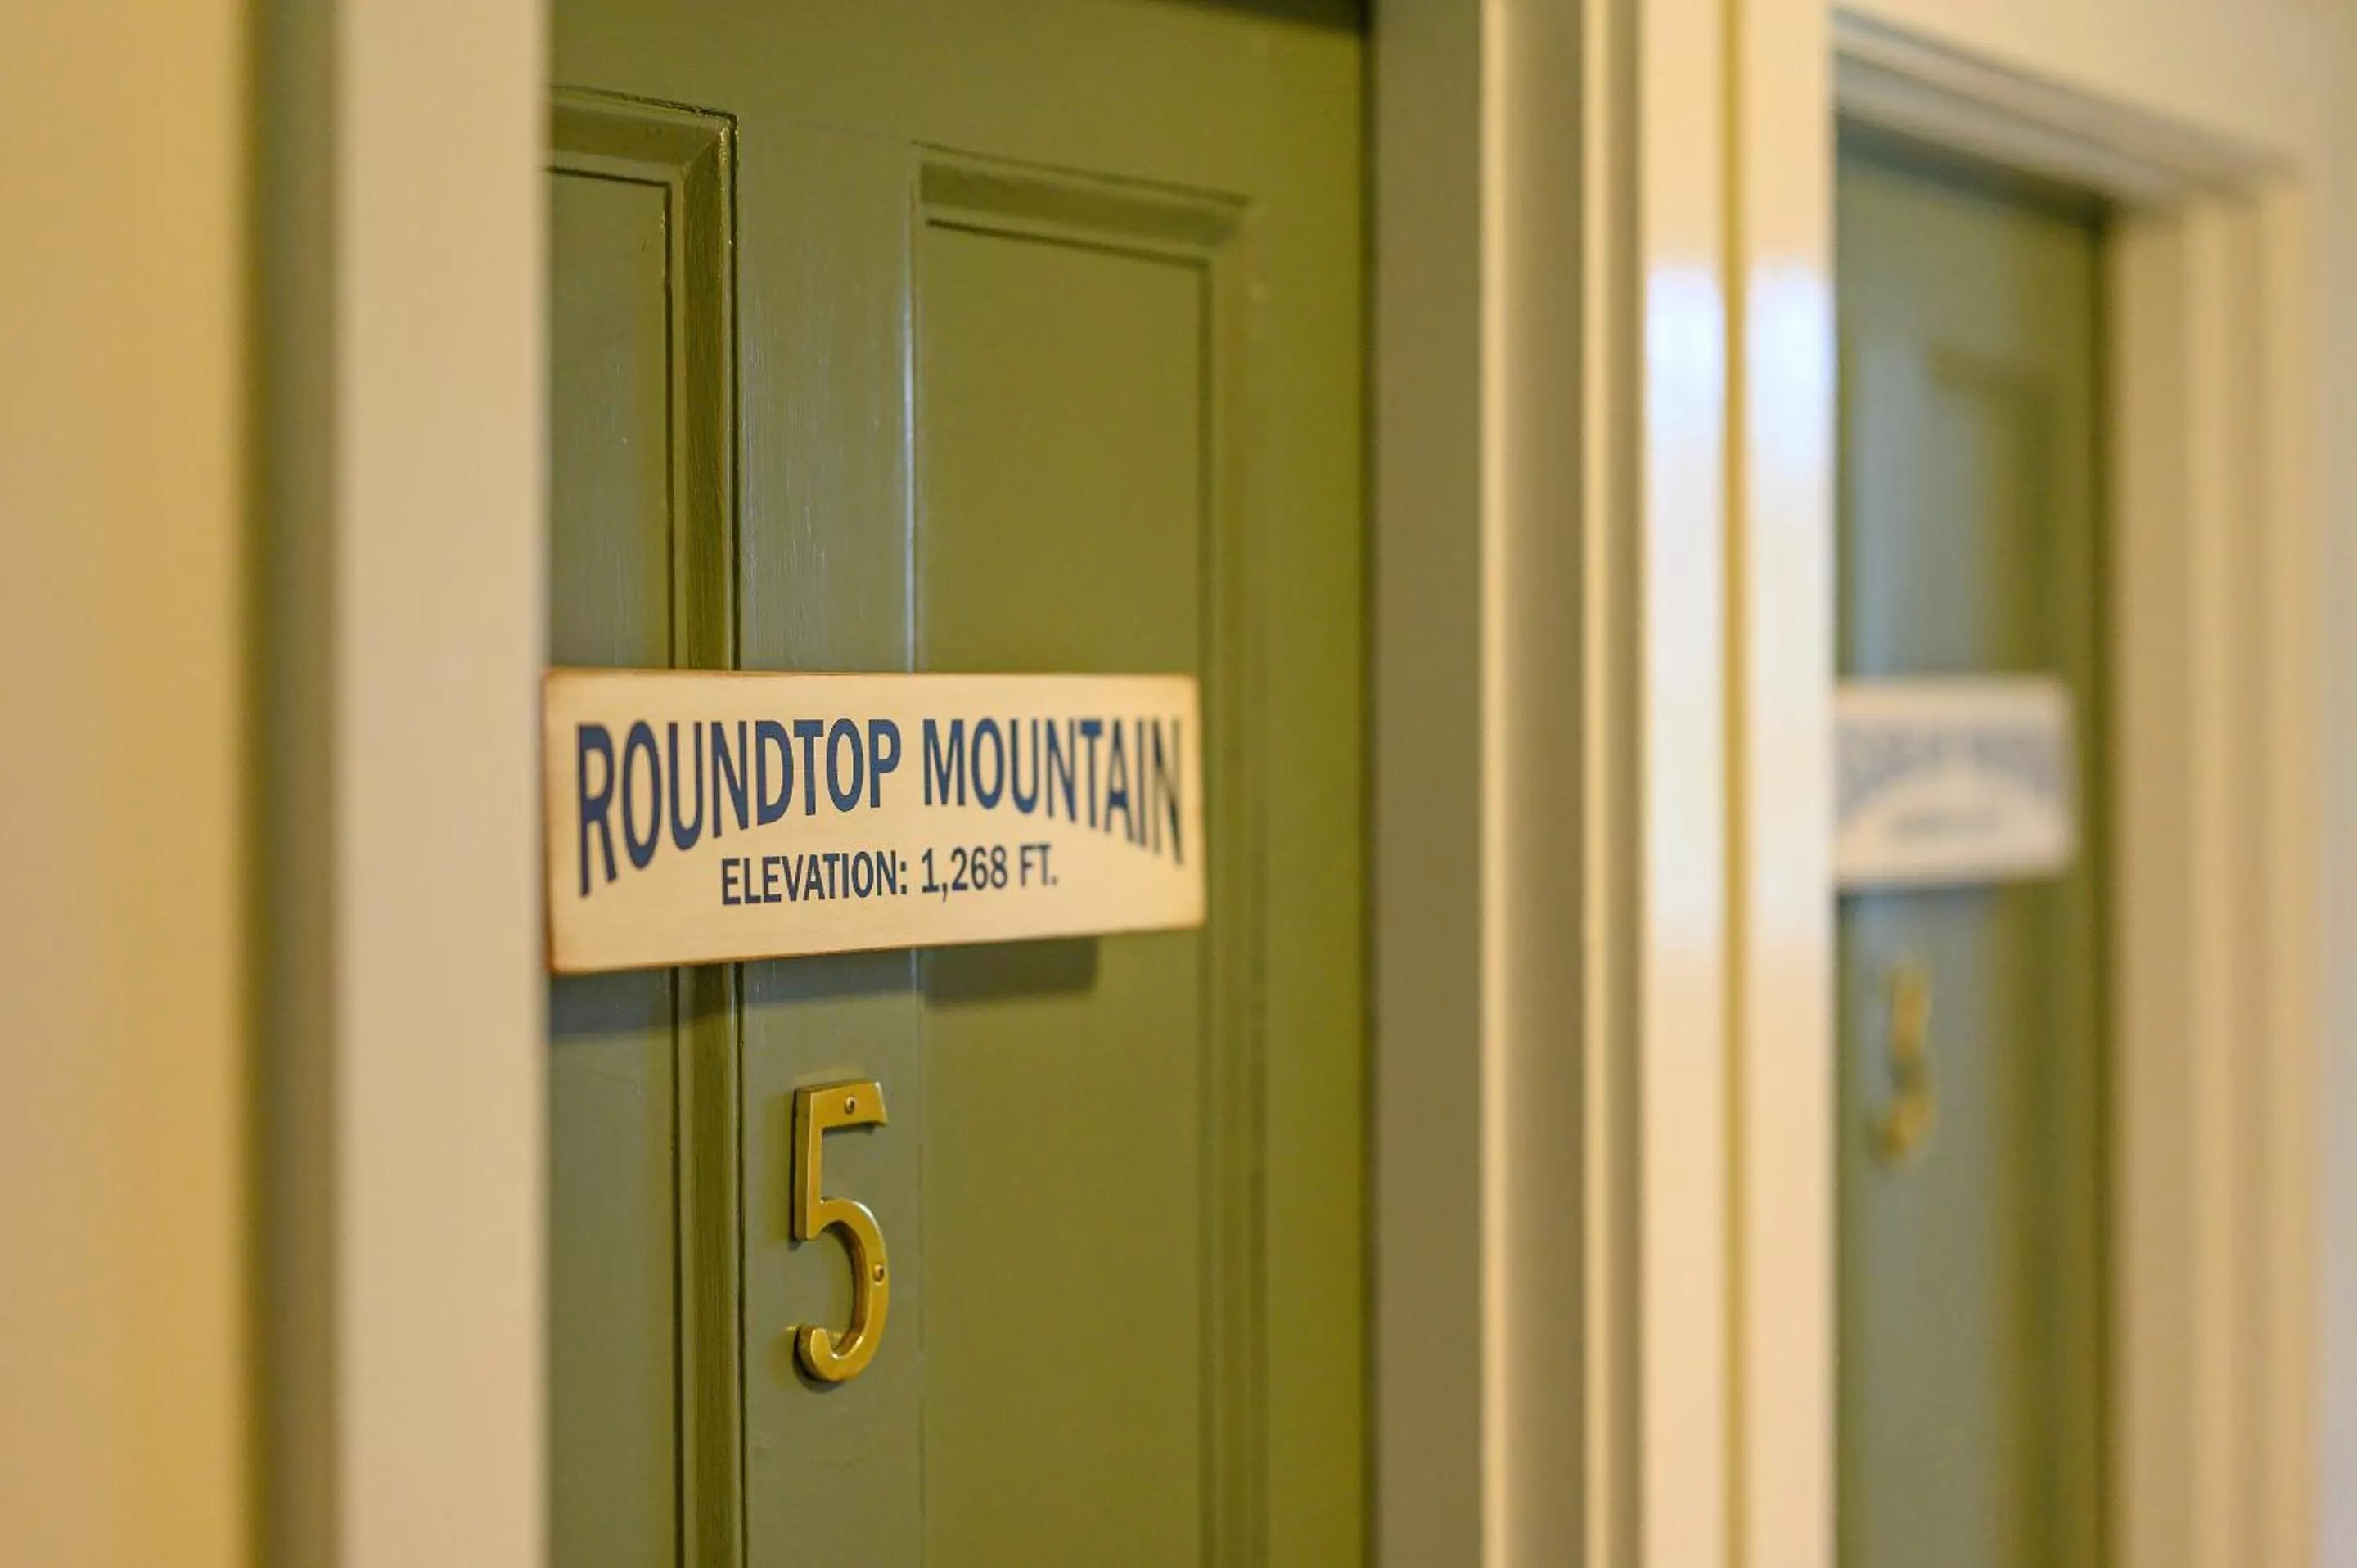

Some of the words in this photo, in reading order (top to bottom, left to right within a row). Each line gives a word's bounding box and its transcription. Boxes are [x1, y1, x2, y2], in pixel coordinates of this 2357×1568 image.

[575, 718, 901, 898] ROUNDTOP
[923, 717, 1184, 867] MOUNTAIN
[720, 849, 908, 906] ELEVATION:
[920, 843, 1009, 903] 1,268
[1018, 843, 1058, 887] FT.
[794, 1081, 890, 1381] 5
